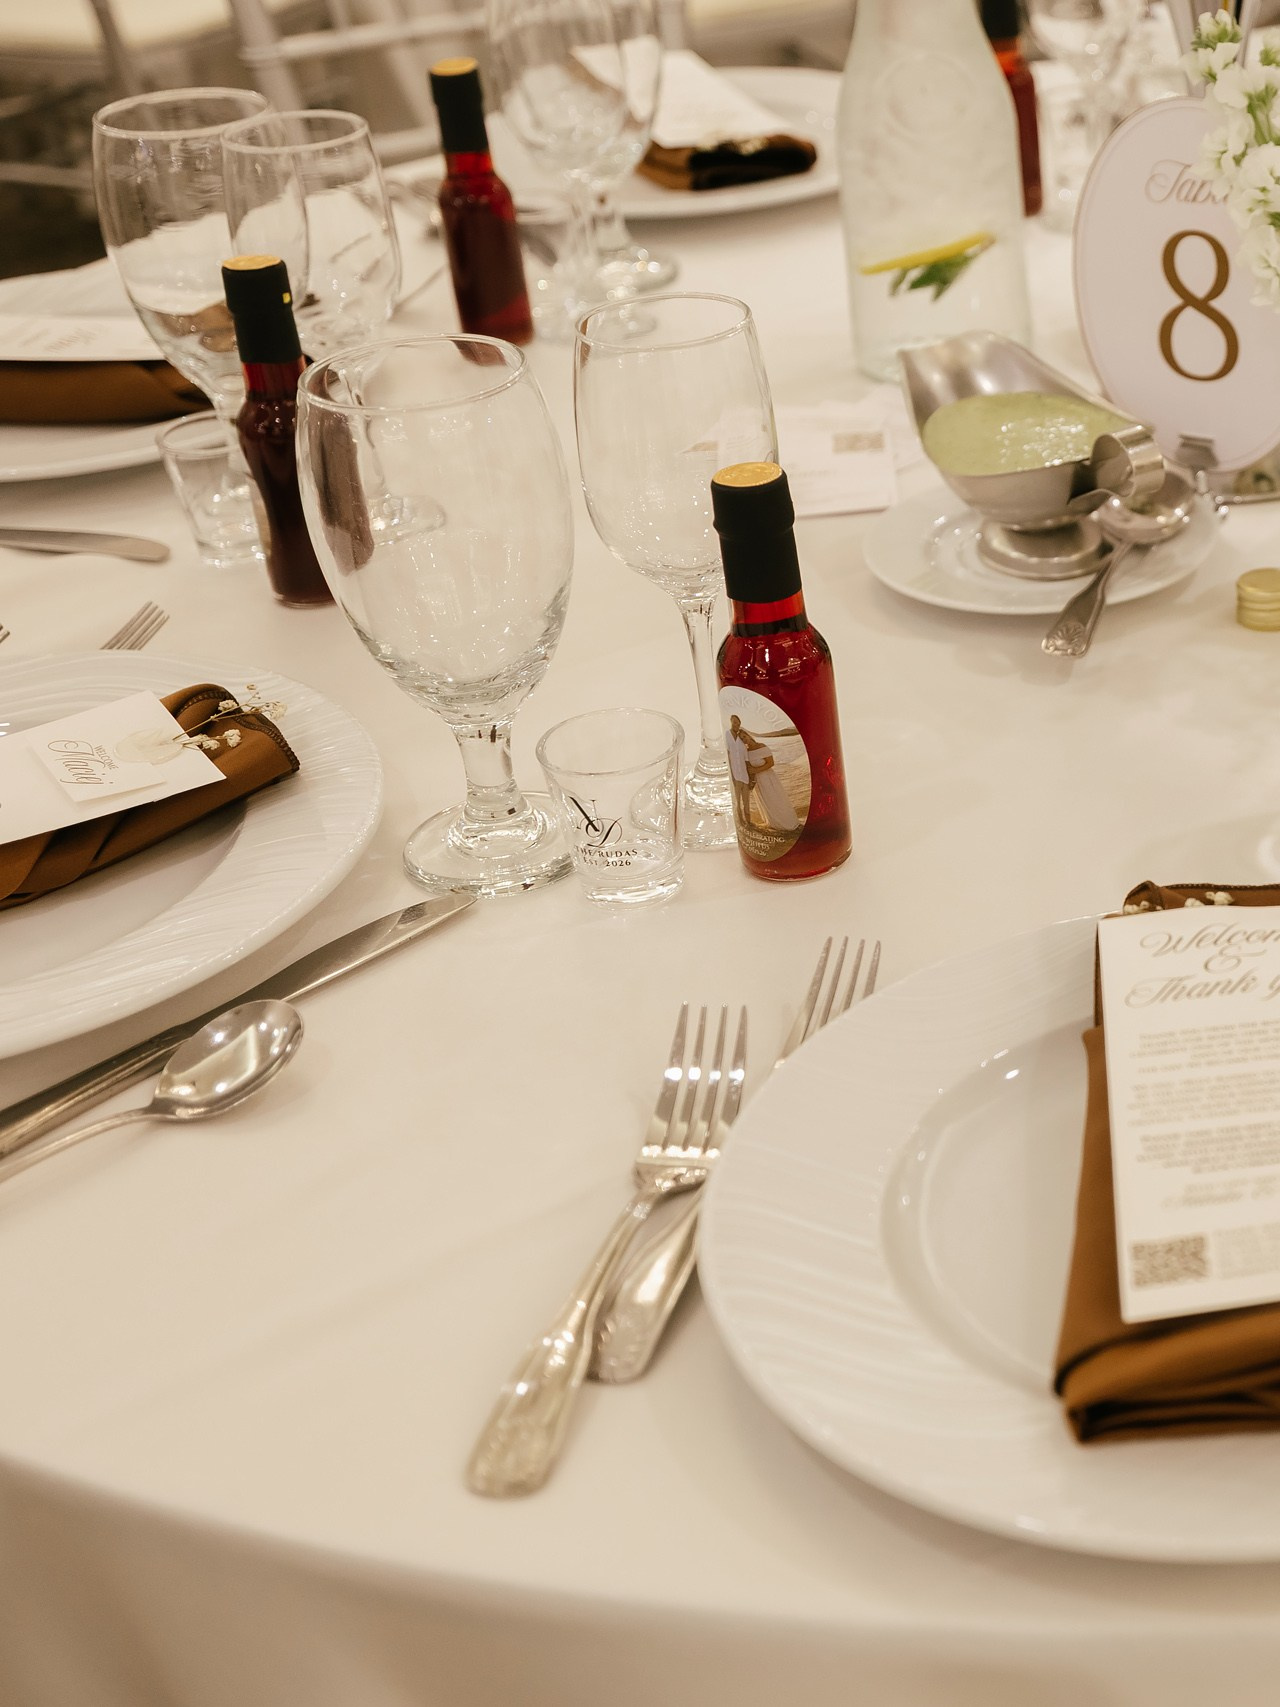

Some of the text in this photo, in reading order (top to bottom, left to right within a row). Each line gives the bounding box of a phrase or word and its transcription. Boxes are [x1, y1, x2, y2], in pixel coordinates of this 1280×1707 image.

[1144, 158, 1234, 204] Tab
[1158, 229, 1240, 382] 8
[47, 739, 114, 785] Maciej
[94, 744, 119, 771] WELCOME
[598, 848, 638, 858] RUDAS
[605, 859, 632, 867] 2026
[1203, 944, 1267, 974] &
[1125, 967, 1259, 1008] Thank
